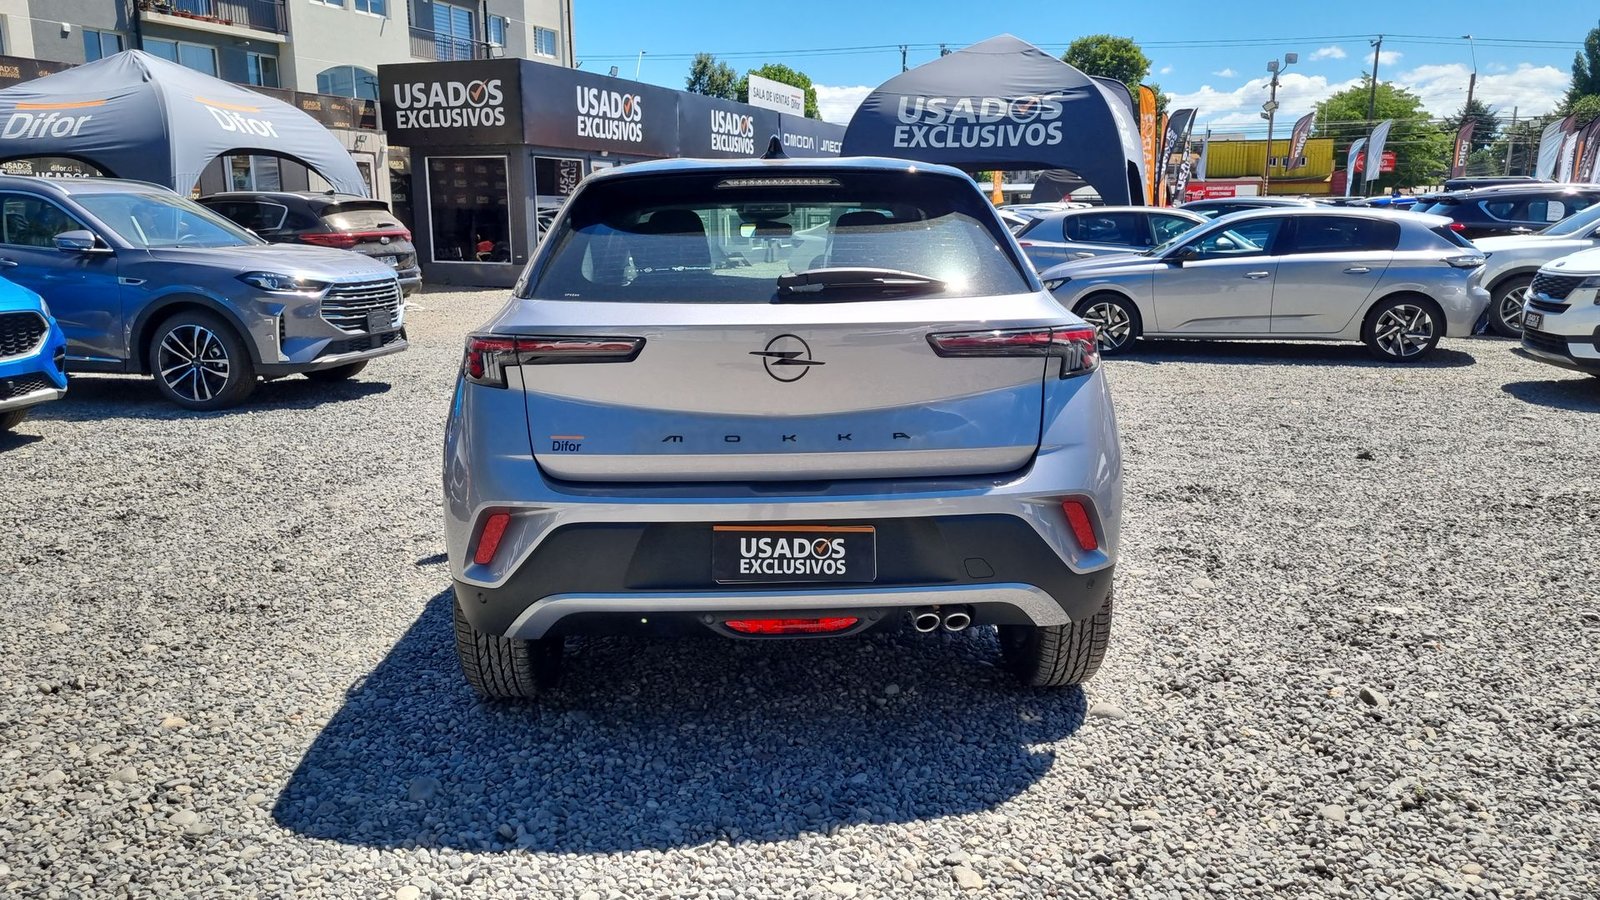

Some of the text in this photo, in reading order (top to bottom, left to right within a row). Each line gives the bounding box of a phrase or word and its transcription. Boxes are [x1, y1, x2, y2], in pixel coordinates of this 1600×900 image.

[394, 79, 503, 108] USADOS
[576, 86, 642, 122] USADOS
[753, 87, 765, 100] SALA
[766, 91, 773, 102] DE
[204, 104, 279, 138] Difor
[397, 107, 505, 128] EXCLUSIVOS
[898, 94, 1063, 124] USADOS
[1, 112, 92, 139] Difor
[577, 115, 643, 143] EXCLUSIVOS
[711, 109, 754, 137] USADOS
[894, 122, 1063, 148] EXCLUSIVOS
[711, 133, 754, 155] EXCLUSIVOS
[783, 133, 815, 150] OMODA
[552, 440, 582, 452] Difor
[661, 432, 912, 443] MOKKA
[739, 538, 846, 560] USADOS
[739, 558, 847, 575] EXCLUSIVOS
